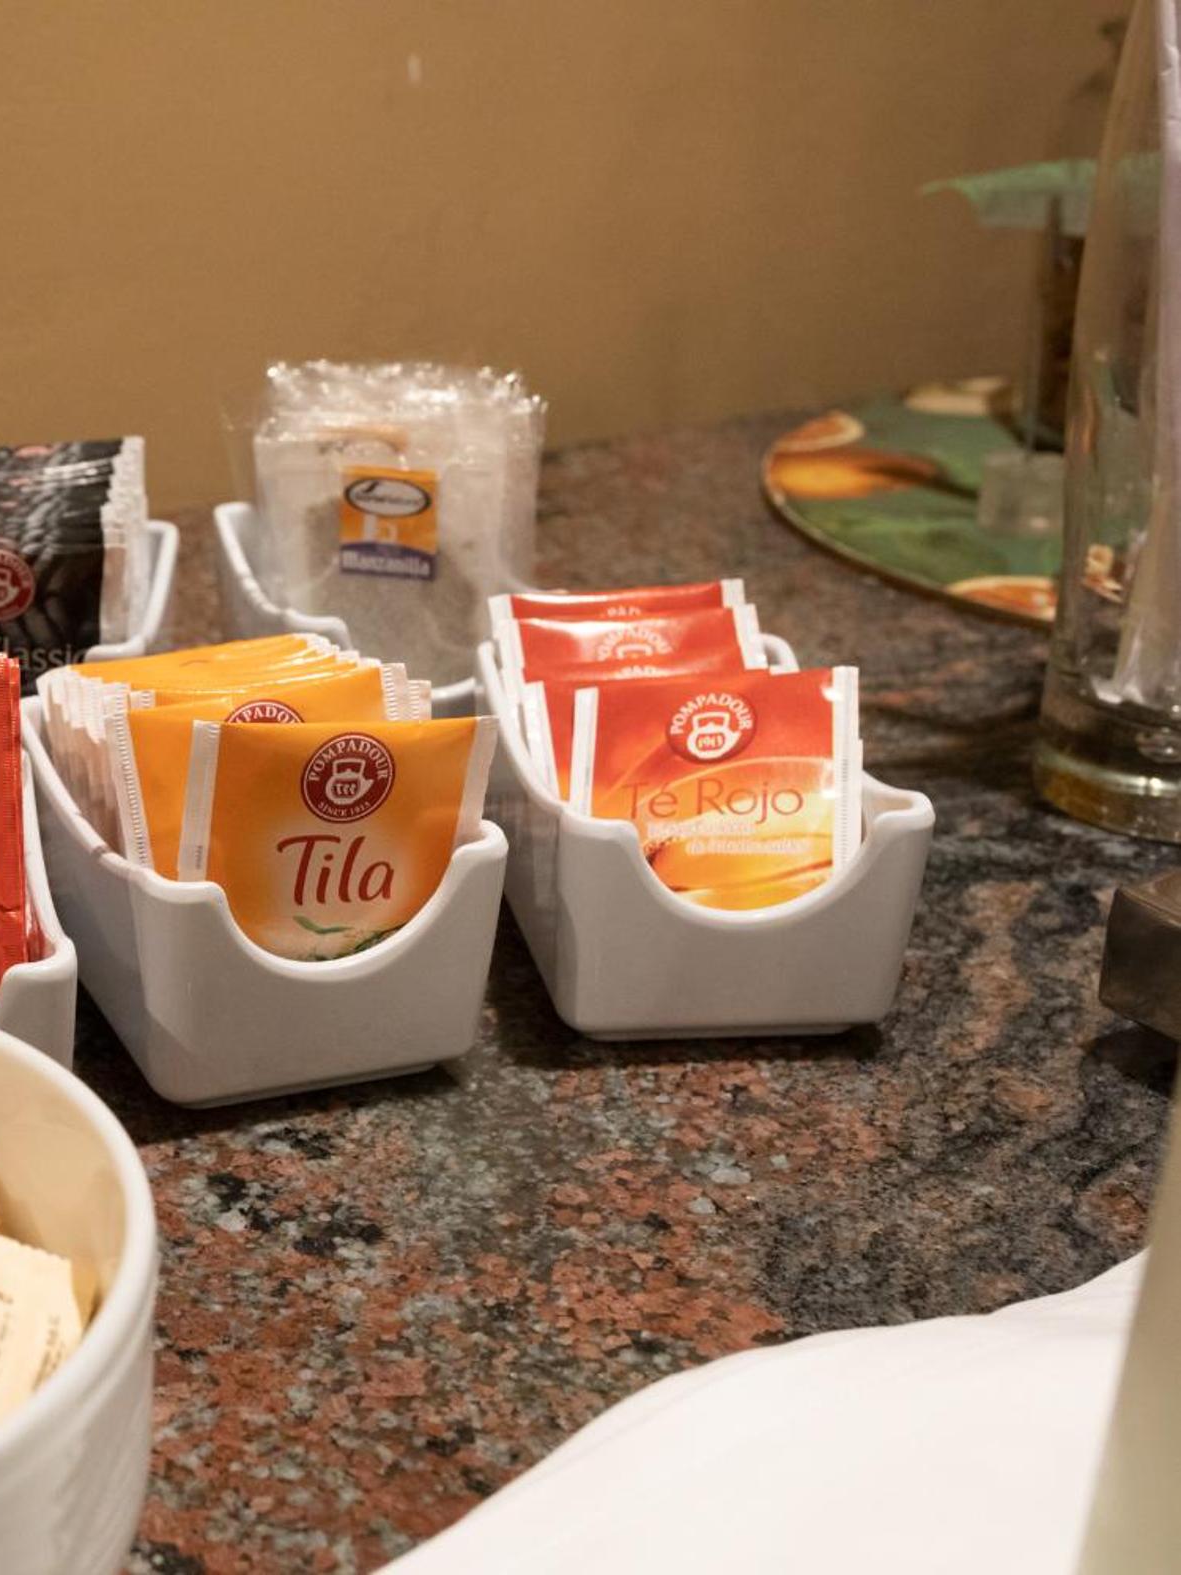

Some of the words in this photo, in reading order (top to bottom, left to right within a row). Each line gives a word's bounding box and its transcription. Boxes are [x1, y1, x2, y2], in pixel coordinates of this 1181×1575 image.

[670, 692, 754, 735] POMPADOUR
[308, 739, 388, 782] POMPADOUR
[318, 801, 348, 817] SINCE
[622, 782, 678, 819] Té
[696, 777, 804, 825] Rojo
[277, 835, 394, 906] Tila
